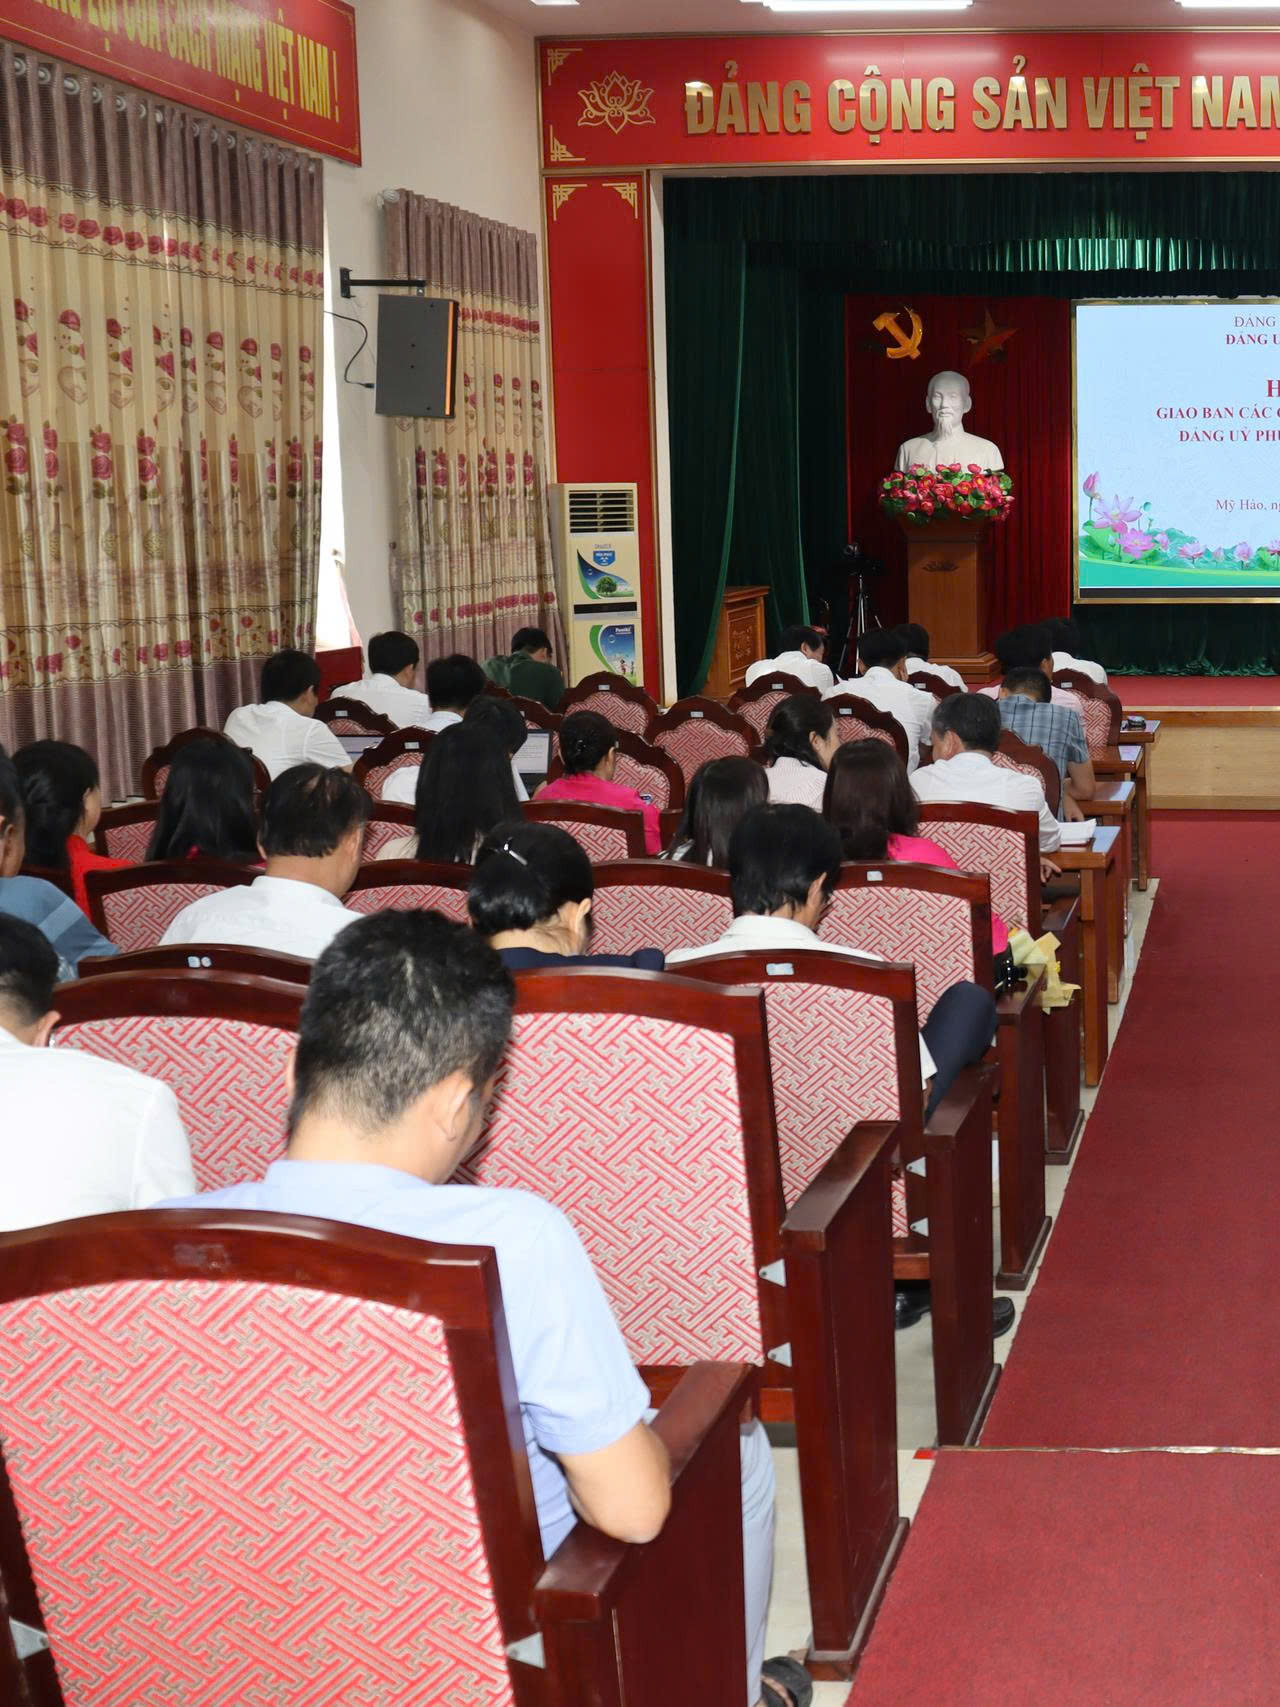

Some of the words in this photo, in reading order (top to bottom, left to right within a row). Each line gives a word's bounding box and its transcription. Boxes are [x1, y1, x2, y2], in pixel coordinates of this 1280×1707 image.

[264, 8, 295, 120] VIỆT
[297, 34, 331, 120] NAM
[685, 60, 811, 134] ĐẢNG
[827, 65, 955, 144] CỘNG
[972, 55, 1067, 131] SẢN
[1083, 64, 1180, 140] VIỆT
[1156, 407, 1198, 419] GIAO
[1202, 407, 1234, 419] BAN
[1239, 403, 1272, 419] CÁC
[1179, 427, 1224, 442] ĐẢNG
[1216, 499, 1235, 512] Mỹ
